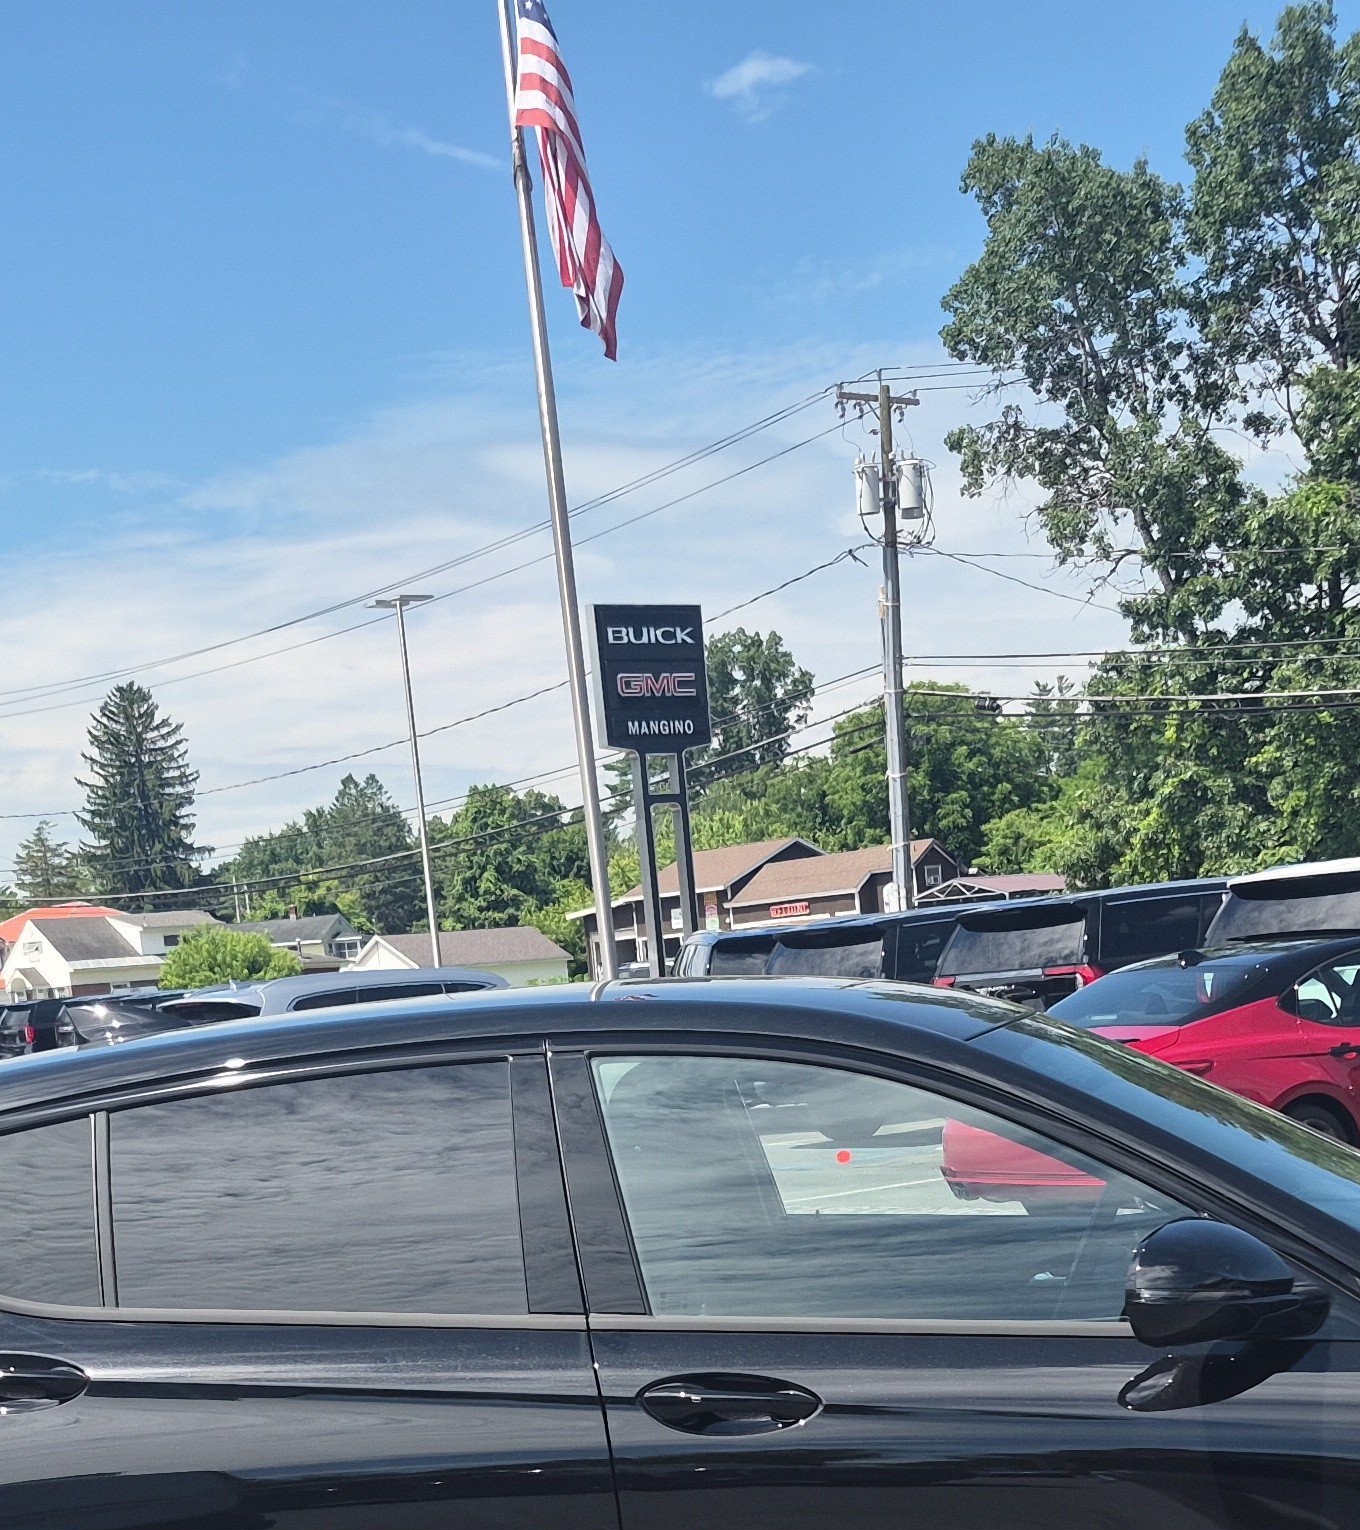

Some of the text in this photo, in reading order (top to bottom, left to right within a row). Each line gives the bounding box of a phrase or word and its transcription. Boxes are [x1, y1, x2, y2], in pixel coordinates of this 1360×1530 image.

[606, 626, 695, 645] BUICK
[616, 672, 697, 698] GMC
[627, 719, 695, 736] MANGINO
